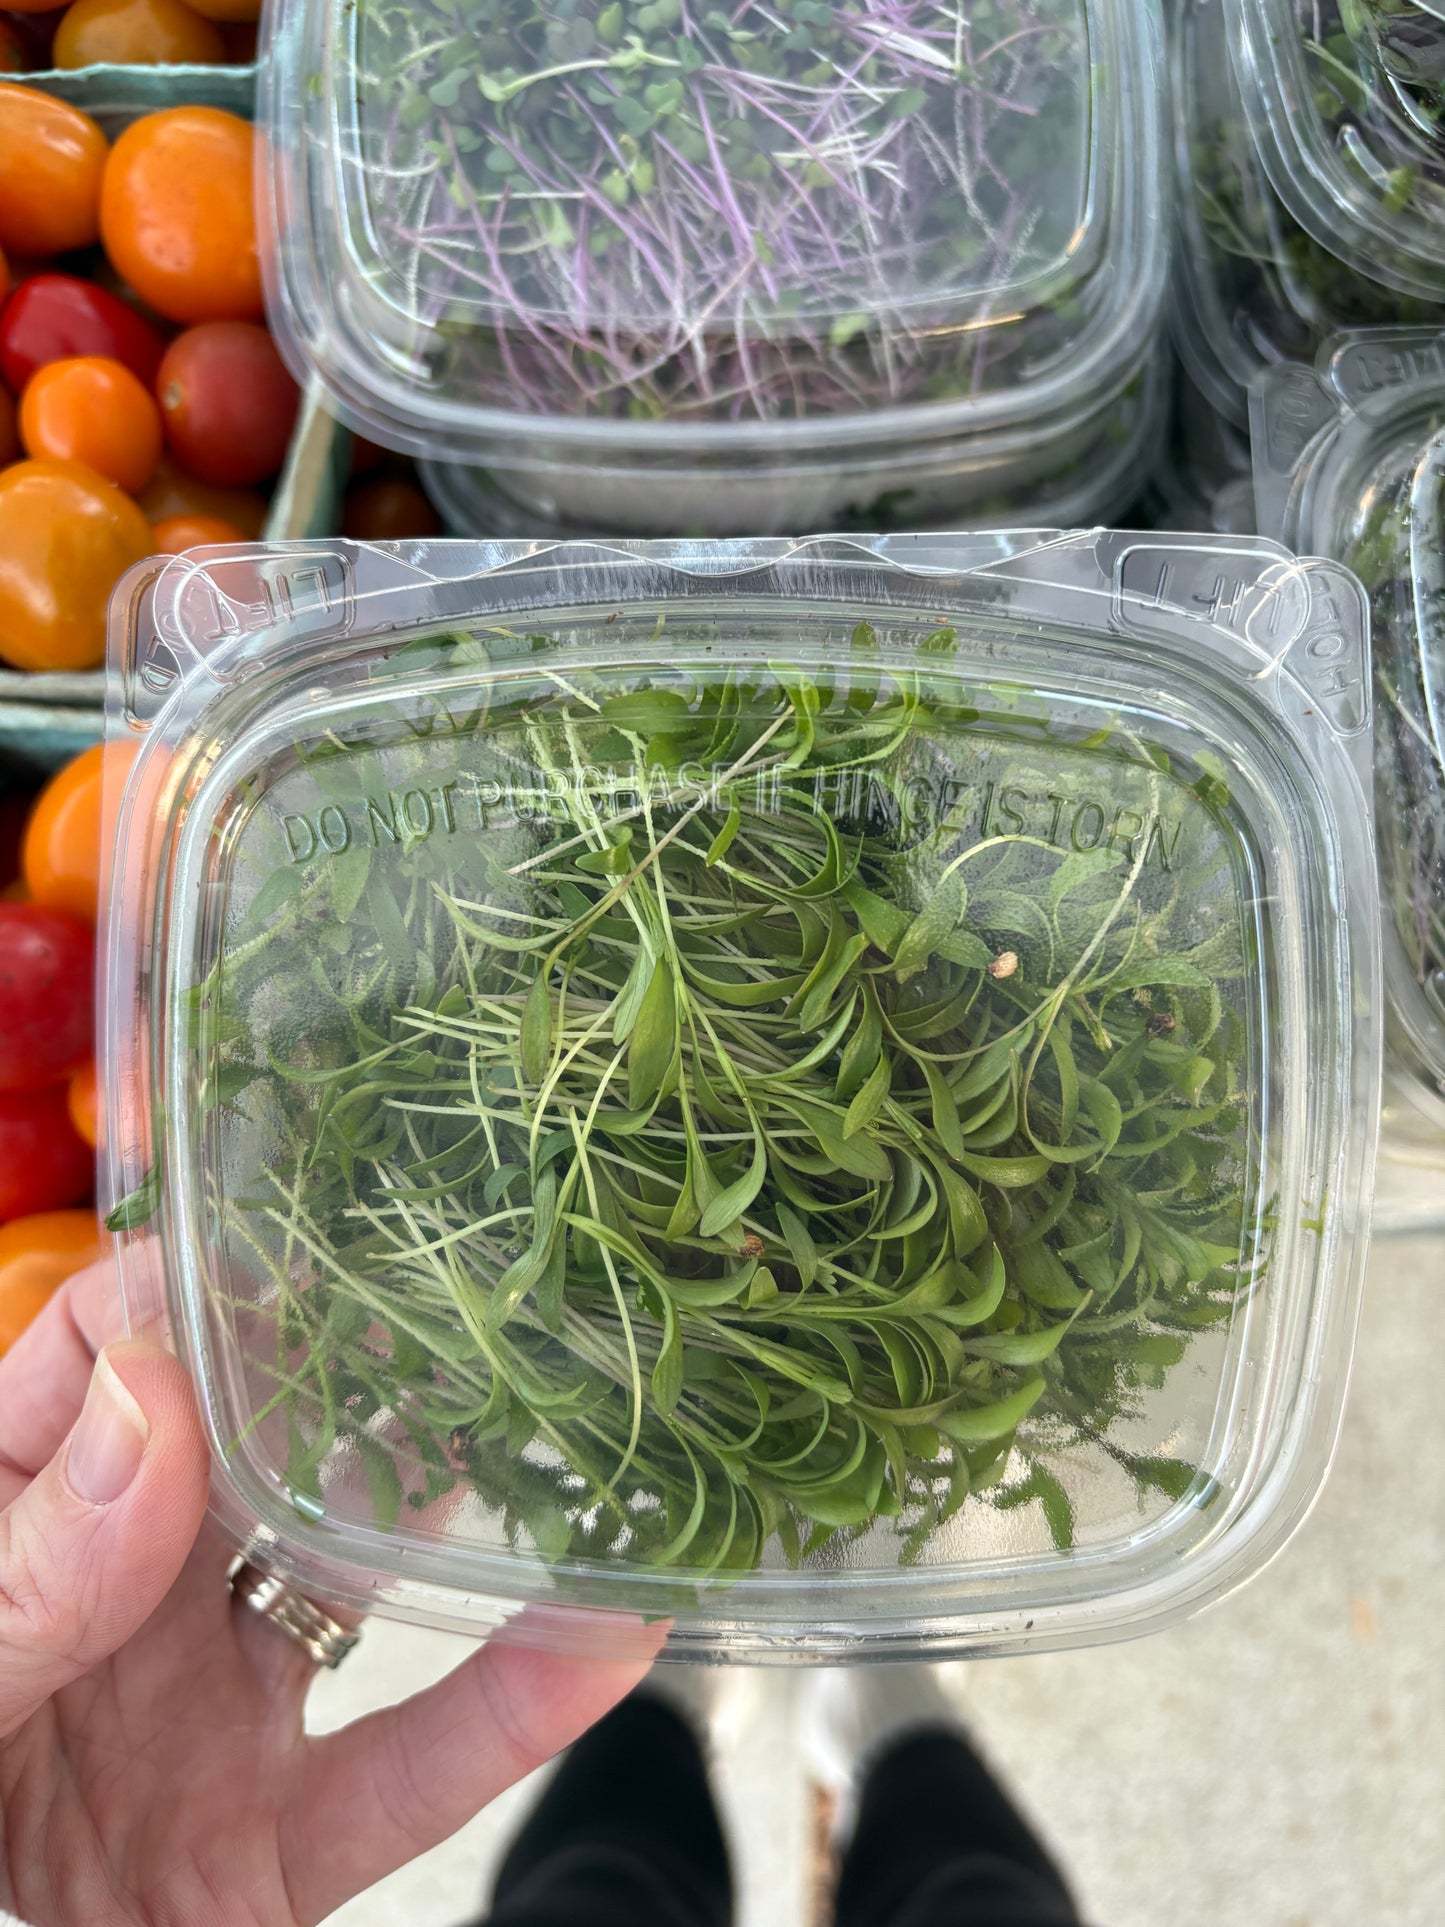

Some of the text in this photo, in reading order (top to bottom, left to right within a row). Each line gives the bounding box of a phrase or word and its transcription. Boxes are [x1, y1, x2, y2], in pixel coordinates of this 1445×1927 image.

[141, 583, 204, 695] OLD
[203, 565, 332, 641] LIFT
[1140, 560, 1281, 636] LIFT
[280, 761, 1181, 873] DO NOT PURCHASE IF HINGE IS TORN
